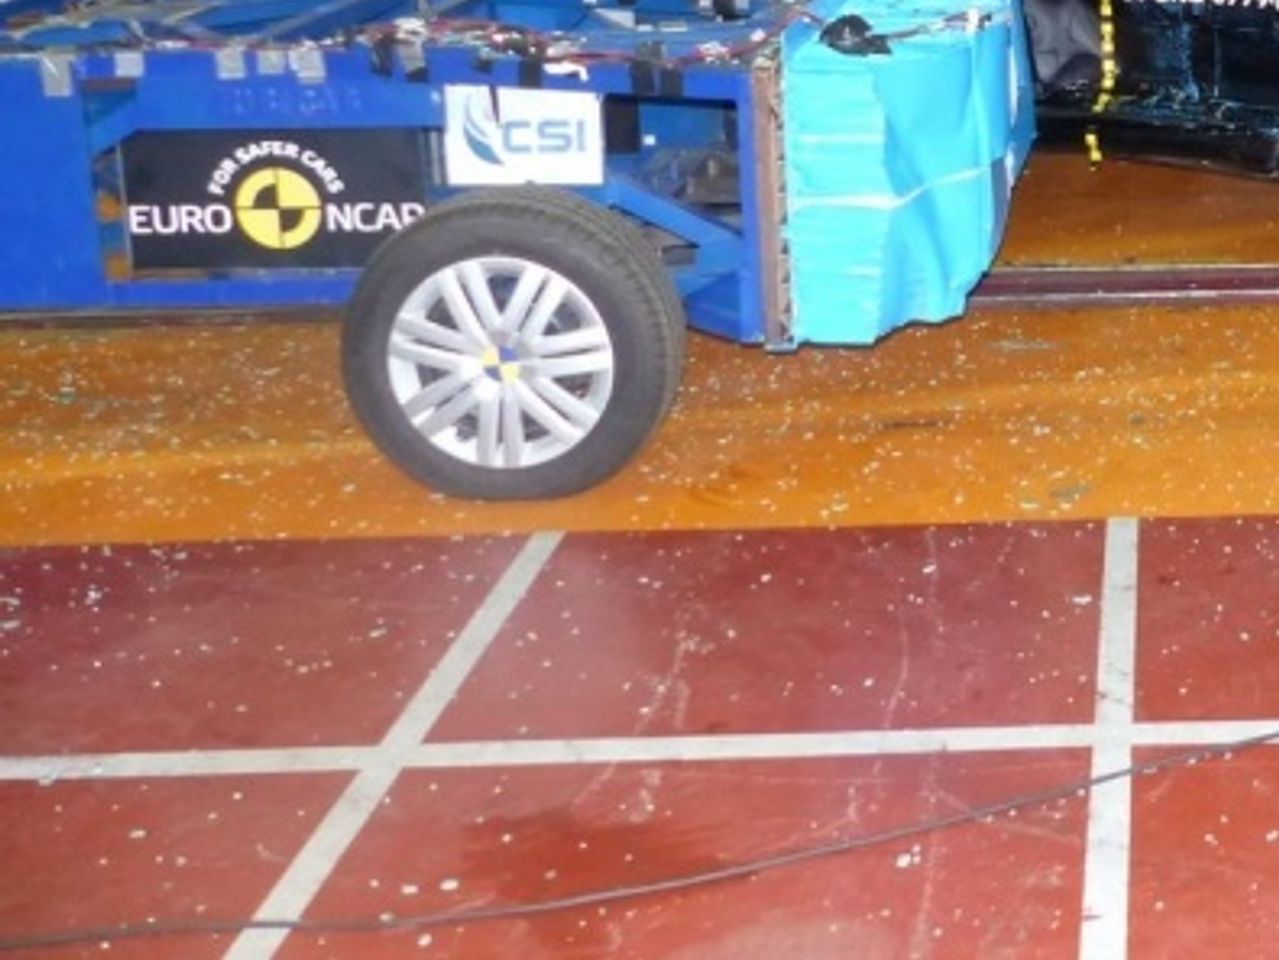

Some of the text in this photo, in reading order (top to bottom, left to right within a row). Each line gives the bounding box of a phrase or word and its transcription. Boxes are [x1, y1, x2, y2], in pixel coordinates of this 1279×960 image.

[503, 119, 588, 154] CSI
[206, 141, 346, 196] FOR SAFER CARS
[127, 203, 233, 234] EURO
